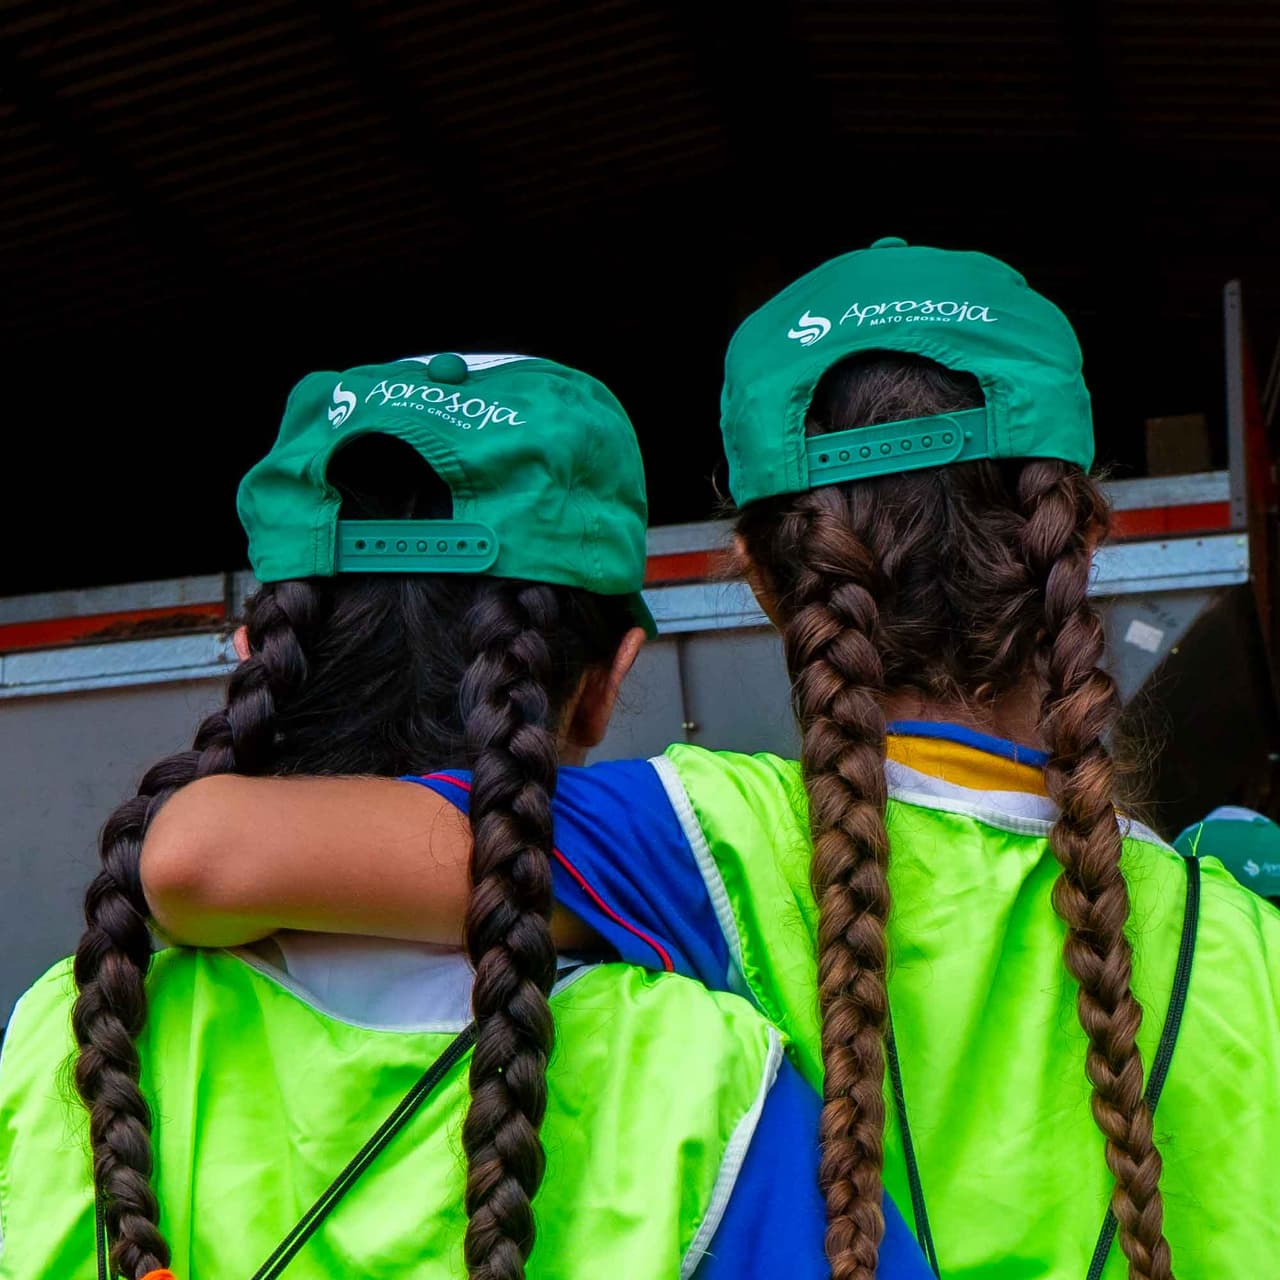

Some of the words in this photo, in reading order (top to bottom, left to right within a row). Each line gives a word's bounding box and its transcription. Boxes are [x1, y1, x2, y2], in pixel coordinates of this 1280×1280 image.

[840, 299, 998, 327] Aprosoja
[870, 315, 901, 327] MATO
[906, 315, 951, 323] GROSSO
[365, 379, 526, 430] Aprosoja
[392, 401, 424, 411] MATO
[427, 406, 472, 430] GROSSO
